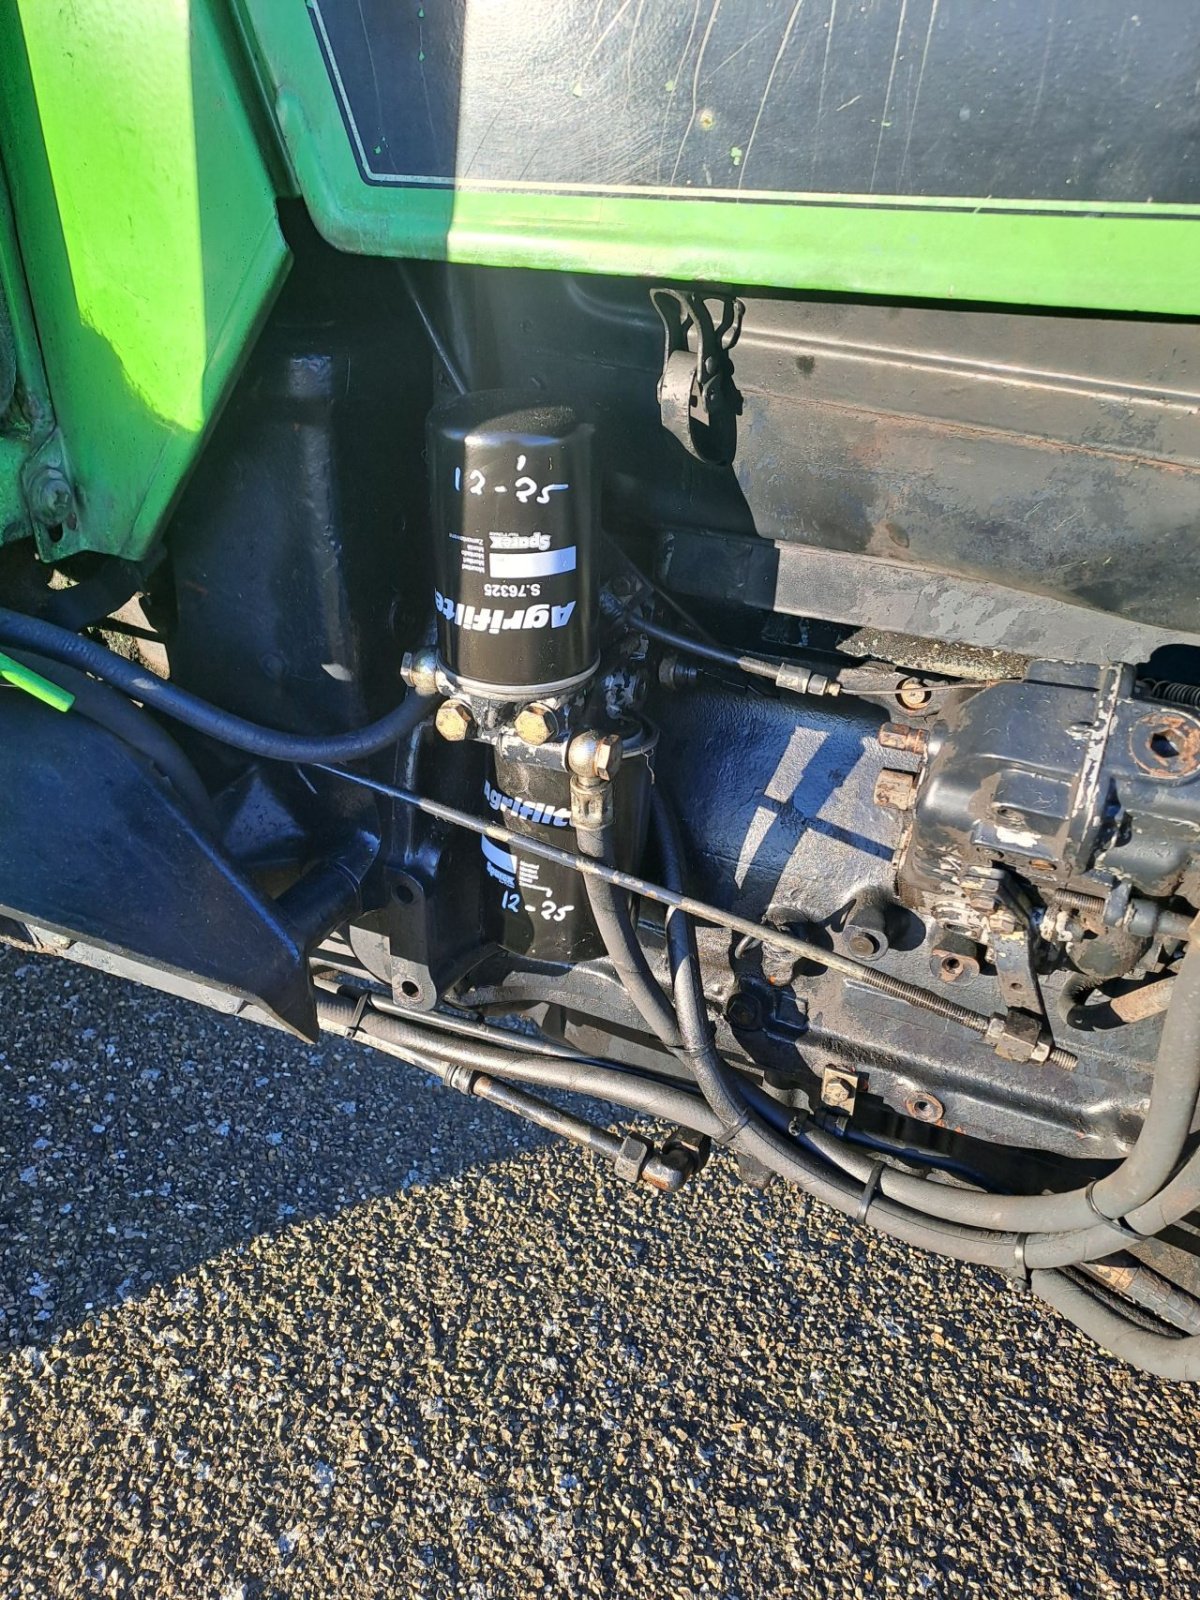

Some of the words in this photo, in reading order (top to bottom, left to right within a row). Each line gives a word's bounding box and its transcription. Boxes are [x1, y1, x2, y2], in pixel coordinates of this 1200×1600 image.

[489, 532, 551, 551] Sparex
[484, 583, 541, 597] S.76325
[434, 587, 576, 635] Agrifilte
[483, 779, 574, 827] Agrifilt
